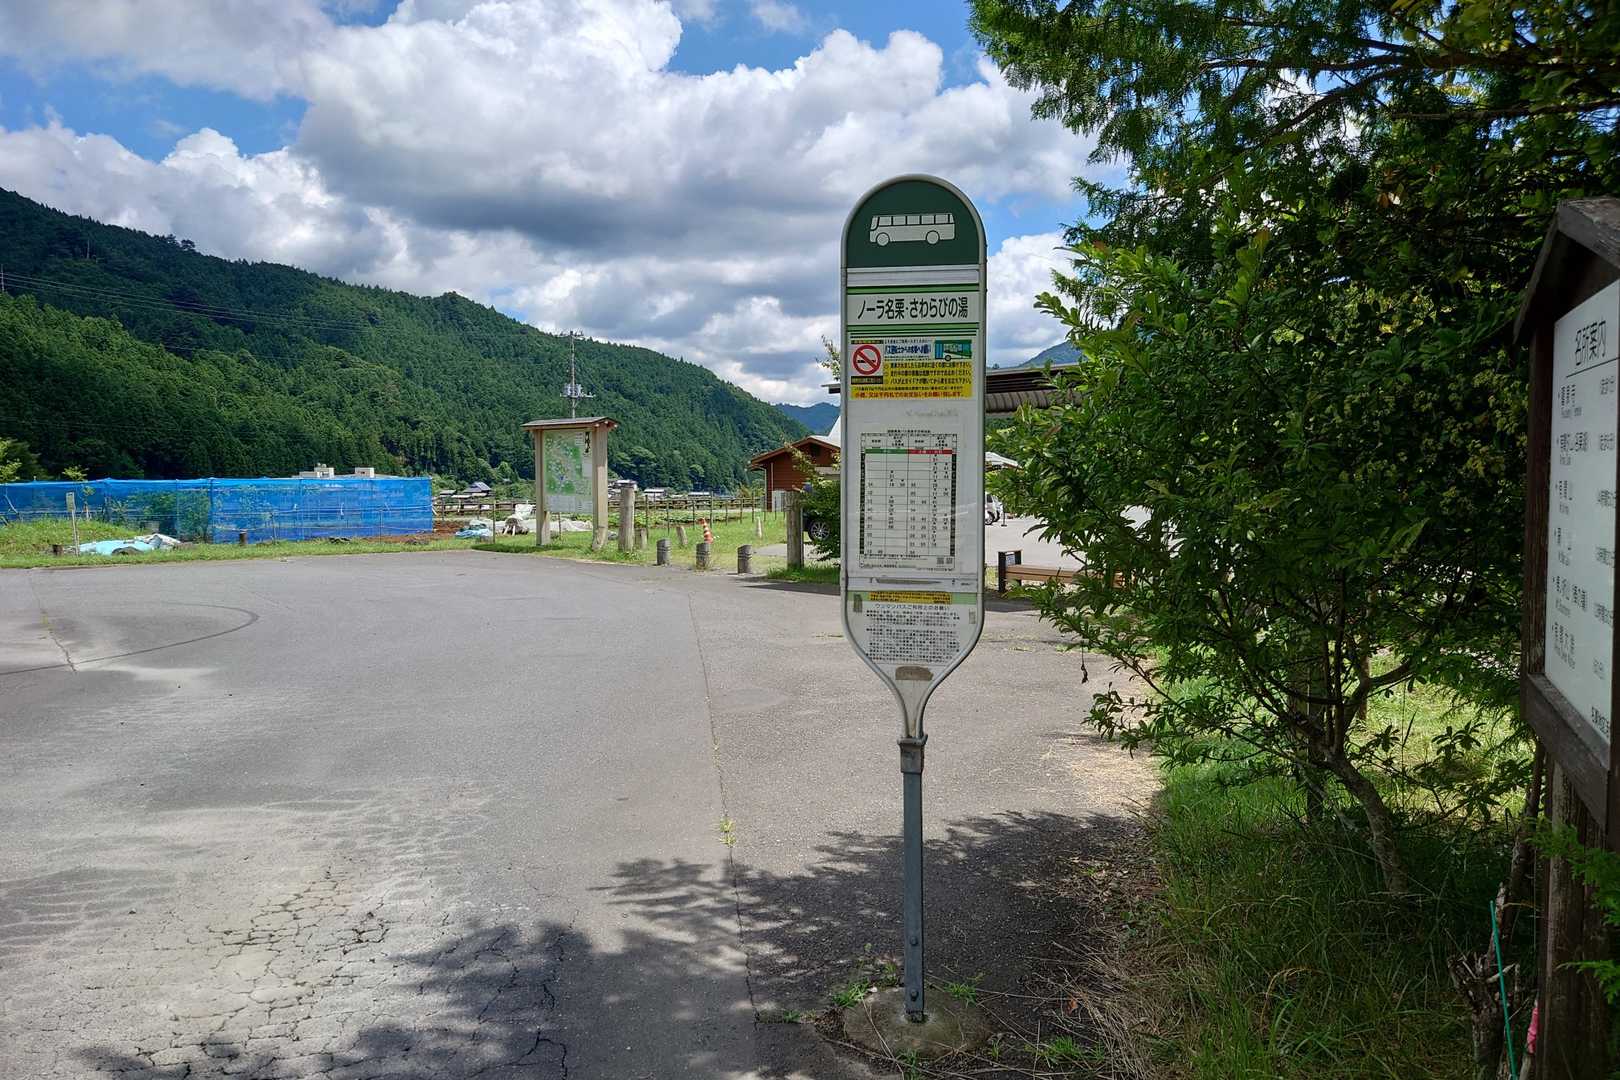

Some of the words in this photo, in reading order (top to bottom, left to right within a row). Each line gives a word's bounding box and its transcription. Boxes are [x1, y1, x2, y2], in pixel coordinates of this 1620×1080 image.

[857, 296, 969, 320] ノーラ名栗・さわらびの湯
[1575, 318, 1607, 367] 名所案内
